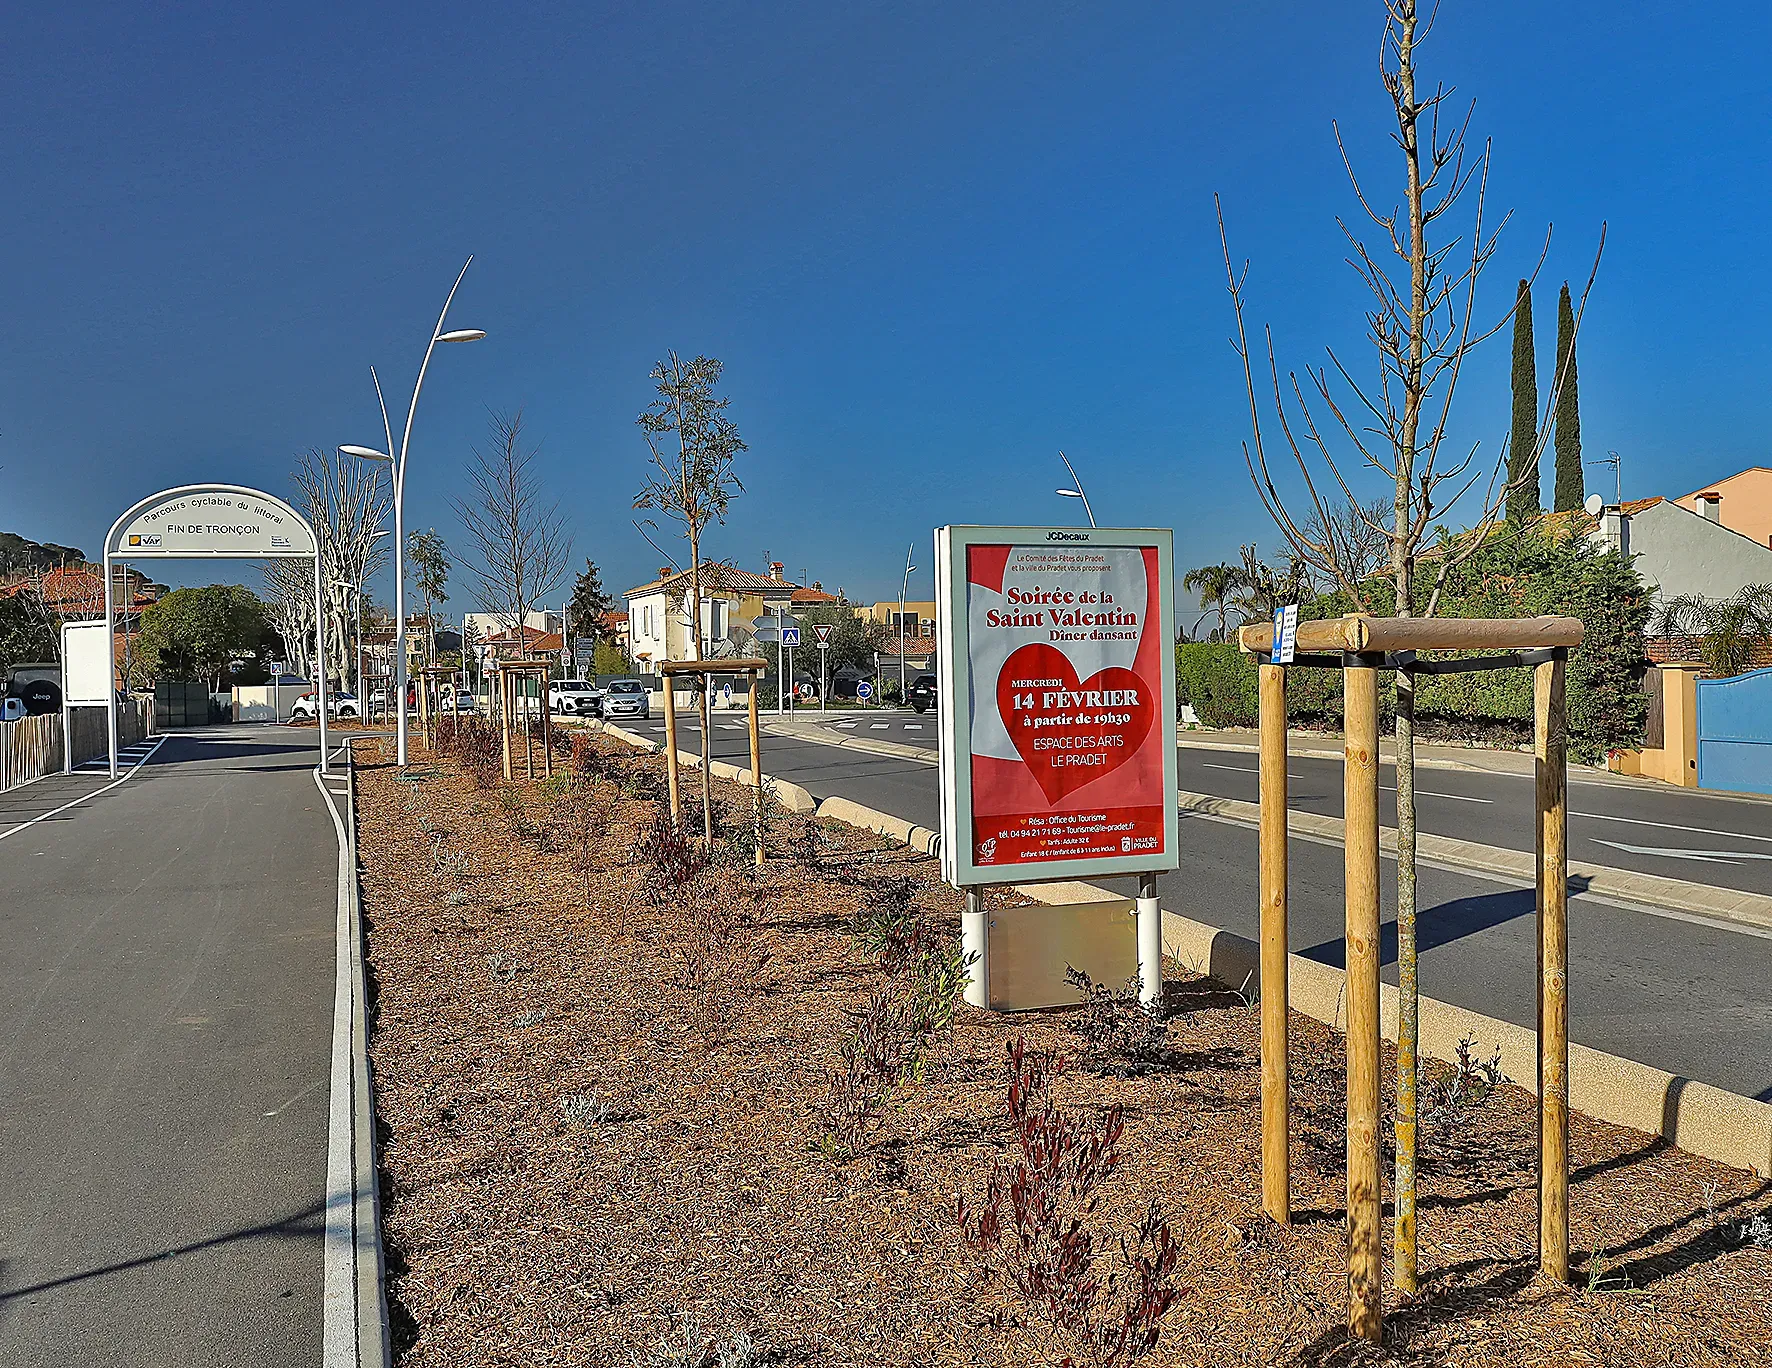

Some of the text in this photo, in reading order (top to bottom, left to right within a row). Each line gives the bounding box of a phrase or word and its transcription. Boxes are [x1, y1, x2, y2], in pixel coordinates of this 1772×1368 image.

[143, 497, 284, 525] Parcours cyclable du littoral
[167, 524, 260, 536] FIN DE TRONÇON
[1045, 531, 1090, 541] JCDecaux
[1025, 554, 1047, 562] Comité
[1047, 554, 1059, 562] des
[1059, 554, 1075, 562] Fêtes
[1075, 554, 1084, 562] du
[1084, 554, 1105, 562] Pradet
[1011, 564, 1112, 573] et la ville du Pradet vous proposent
[1007, 585, 1114, 605] Soirée de la
[986, 606, 1138, 628] Saint Valentin
[1049, 628, 1138, 641] Dîner dansant
[1011, 678, 1063, 688] MERCREDI
[32, 693, 51, 701] Jeep
[1012, 686, 1140, 710] 14 FÉVRIER
[1023, 711, 1131, 729] à partir de 19h30
[1033, 734, 1124, 750] ESPACE DES ARTS
[1051, 753, 1108, 767] LE PRADET
[1028, 817, 1045, 826] Résa
[1048, 815, 1068, 825] Office
[1067, 814, 1077, 824] du
[1077, 813, 1107, 823] Tourisme
[1010, 830, 1020, 838] 04
[1020, 829, 1031, 837] 94
[1031, 828, 1041, 837] 21
[1041, 828, 1051, 836] 71
[1051, 827, 1062, 836] 69
[1133, 841, 1159, 850] PRADET
[1020, 850, 1038, 858] Enfant
